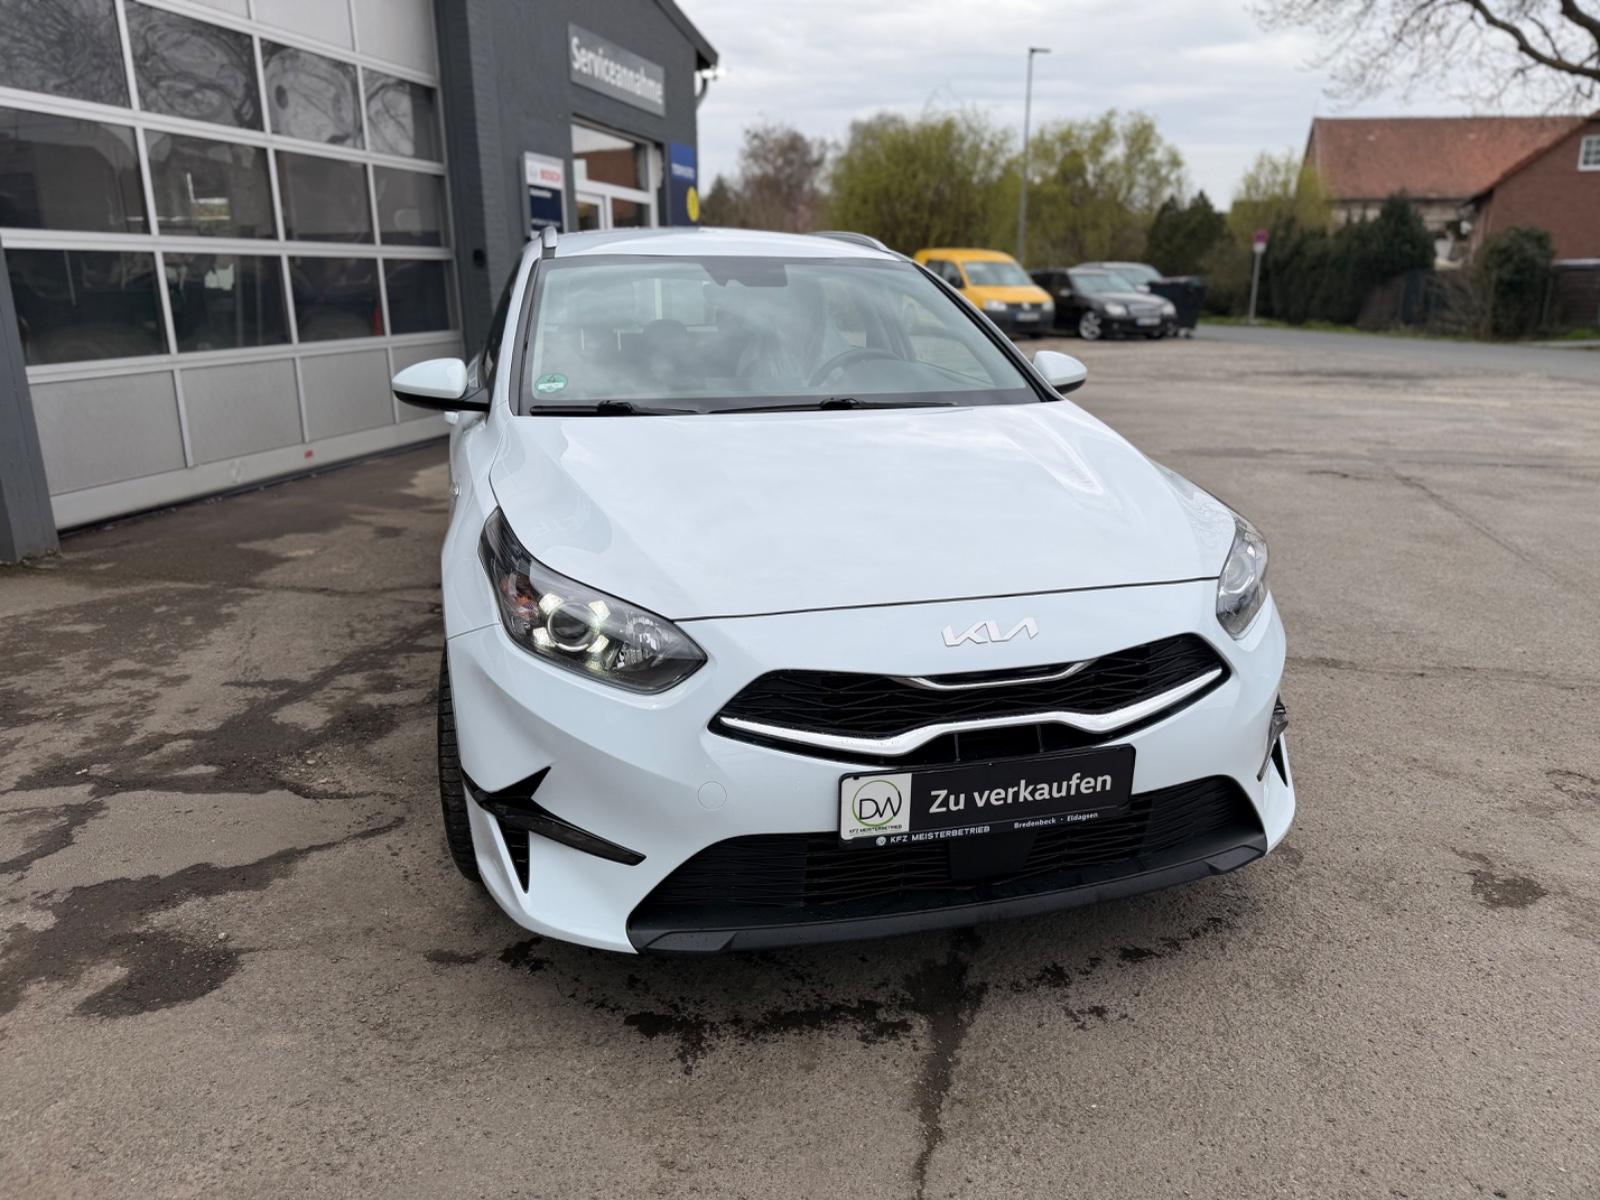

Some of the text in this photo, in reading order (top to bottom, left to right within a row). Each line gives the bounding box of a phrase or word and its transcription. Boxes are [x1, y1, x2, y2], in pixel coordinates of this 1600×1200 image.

[941, 616, 1039, 647] KIA
[929, 772, 1112, 813] Zu verkaufen
[890, 825, 990, 844] KFZ MEISTERBETRIEB
[1013, 817, 1057, 829] Bredenbeck
